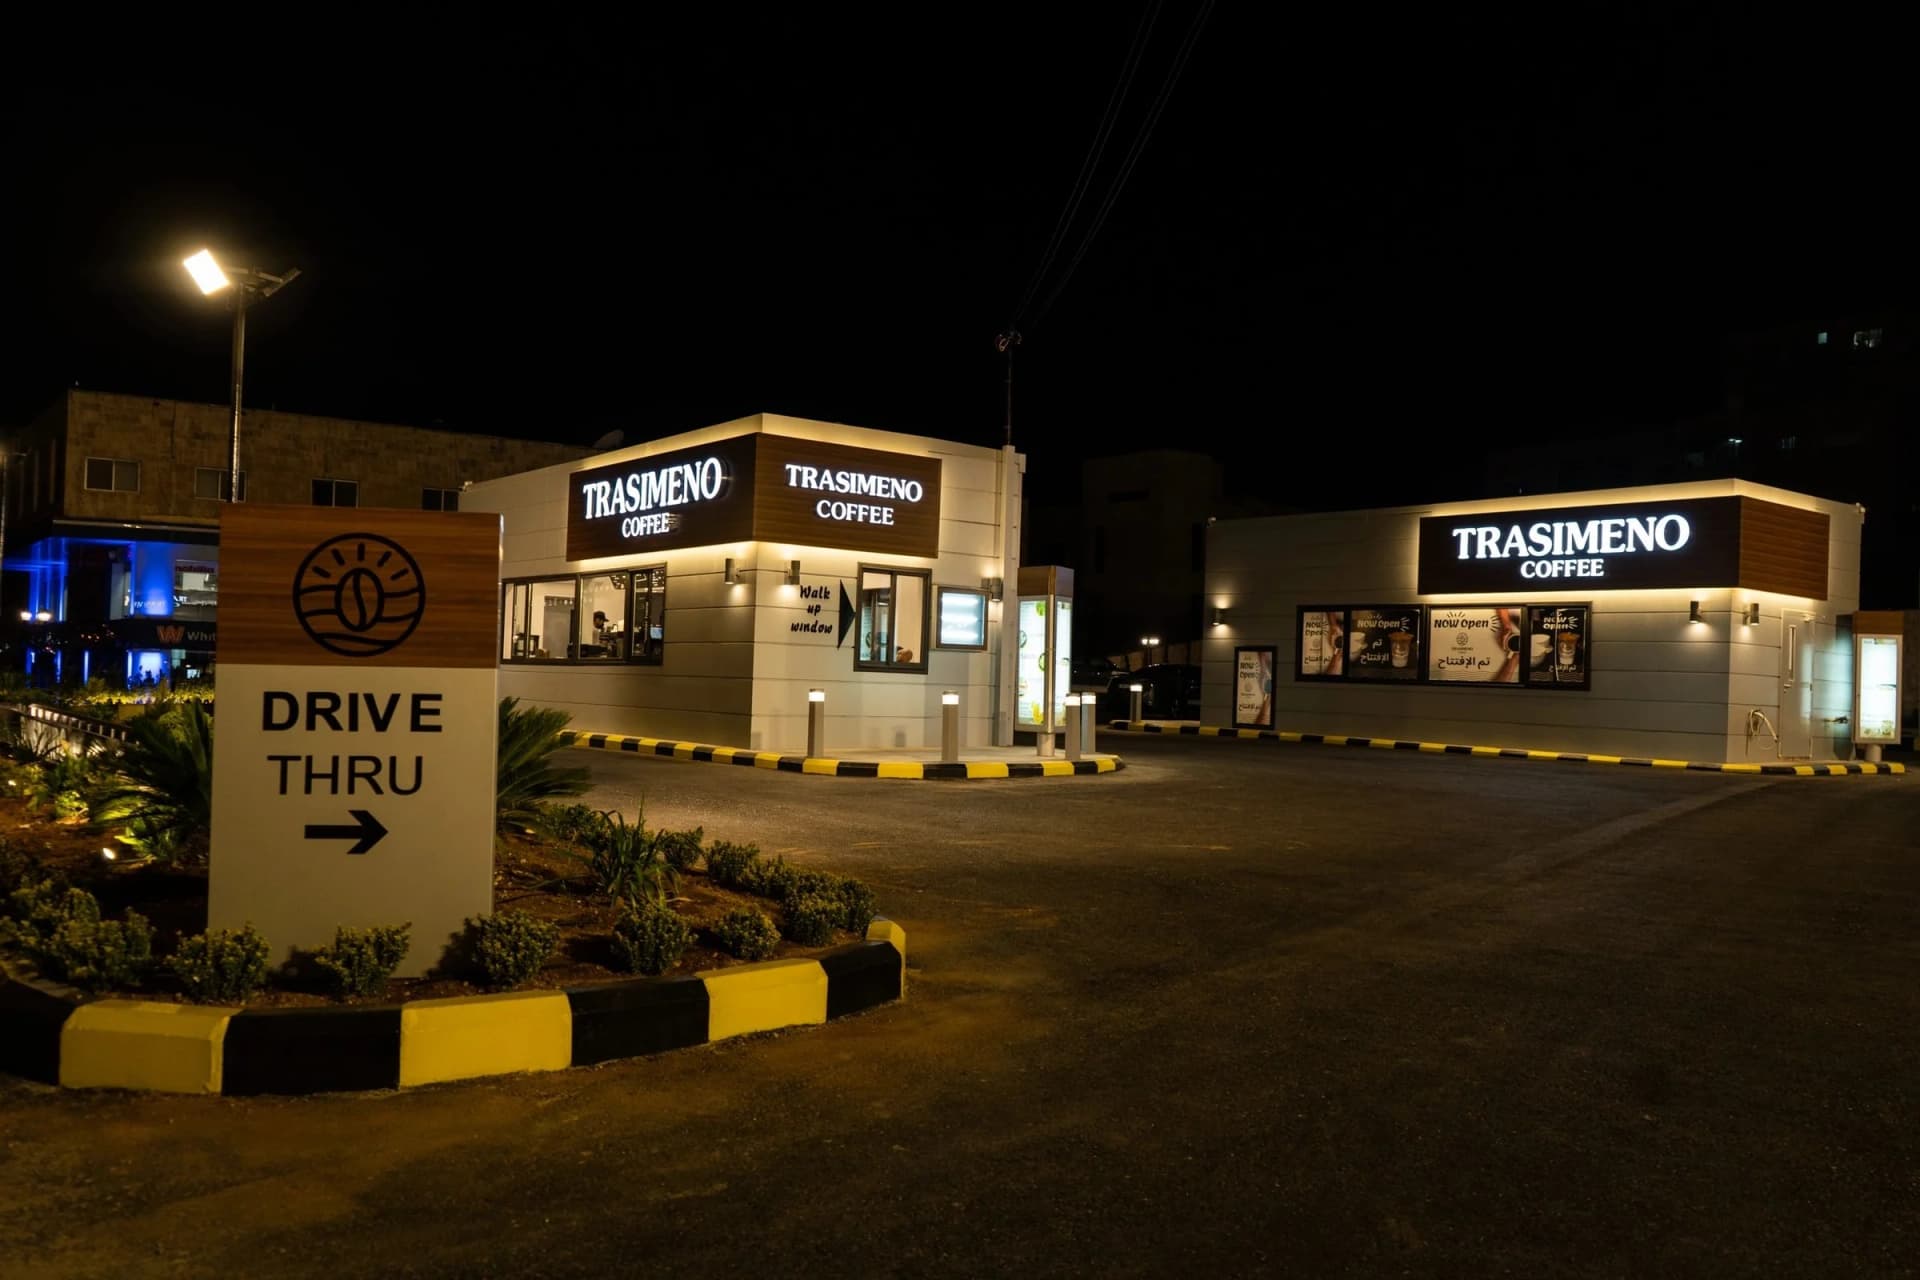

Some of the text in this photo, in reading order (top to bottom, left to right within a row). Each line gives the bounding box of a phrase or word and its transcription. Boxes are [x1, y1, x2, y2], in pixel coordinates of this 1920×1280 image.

[582, 457, 722, 519] TRASIMENO
[785, 464, 923, 502] TRASIMENO
[622, 512, 671, 538] COFFEE
[816, 500, 895, 525] COFFEE
[1452, 514, 1691, 559] TRASIMENO
[1520, 558, 1605, 579] COFFEE
[799, 585, 831, 599] Walk
[806, 603, 821, 616] up
[790, 620, 833, 634] window
[1461, 618, 1489, 630] Open
[1477, 656, 1491, 670] تم
[262, 691, 443, 733] DRIVE
[267, 755, 424, 796] THRU
